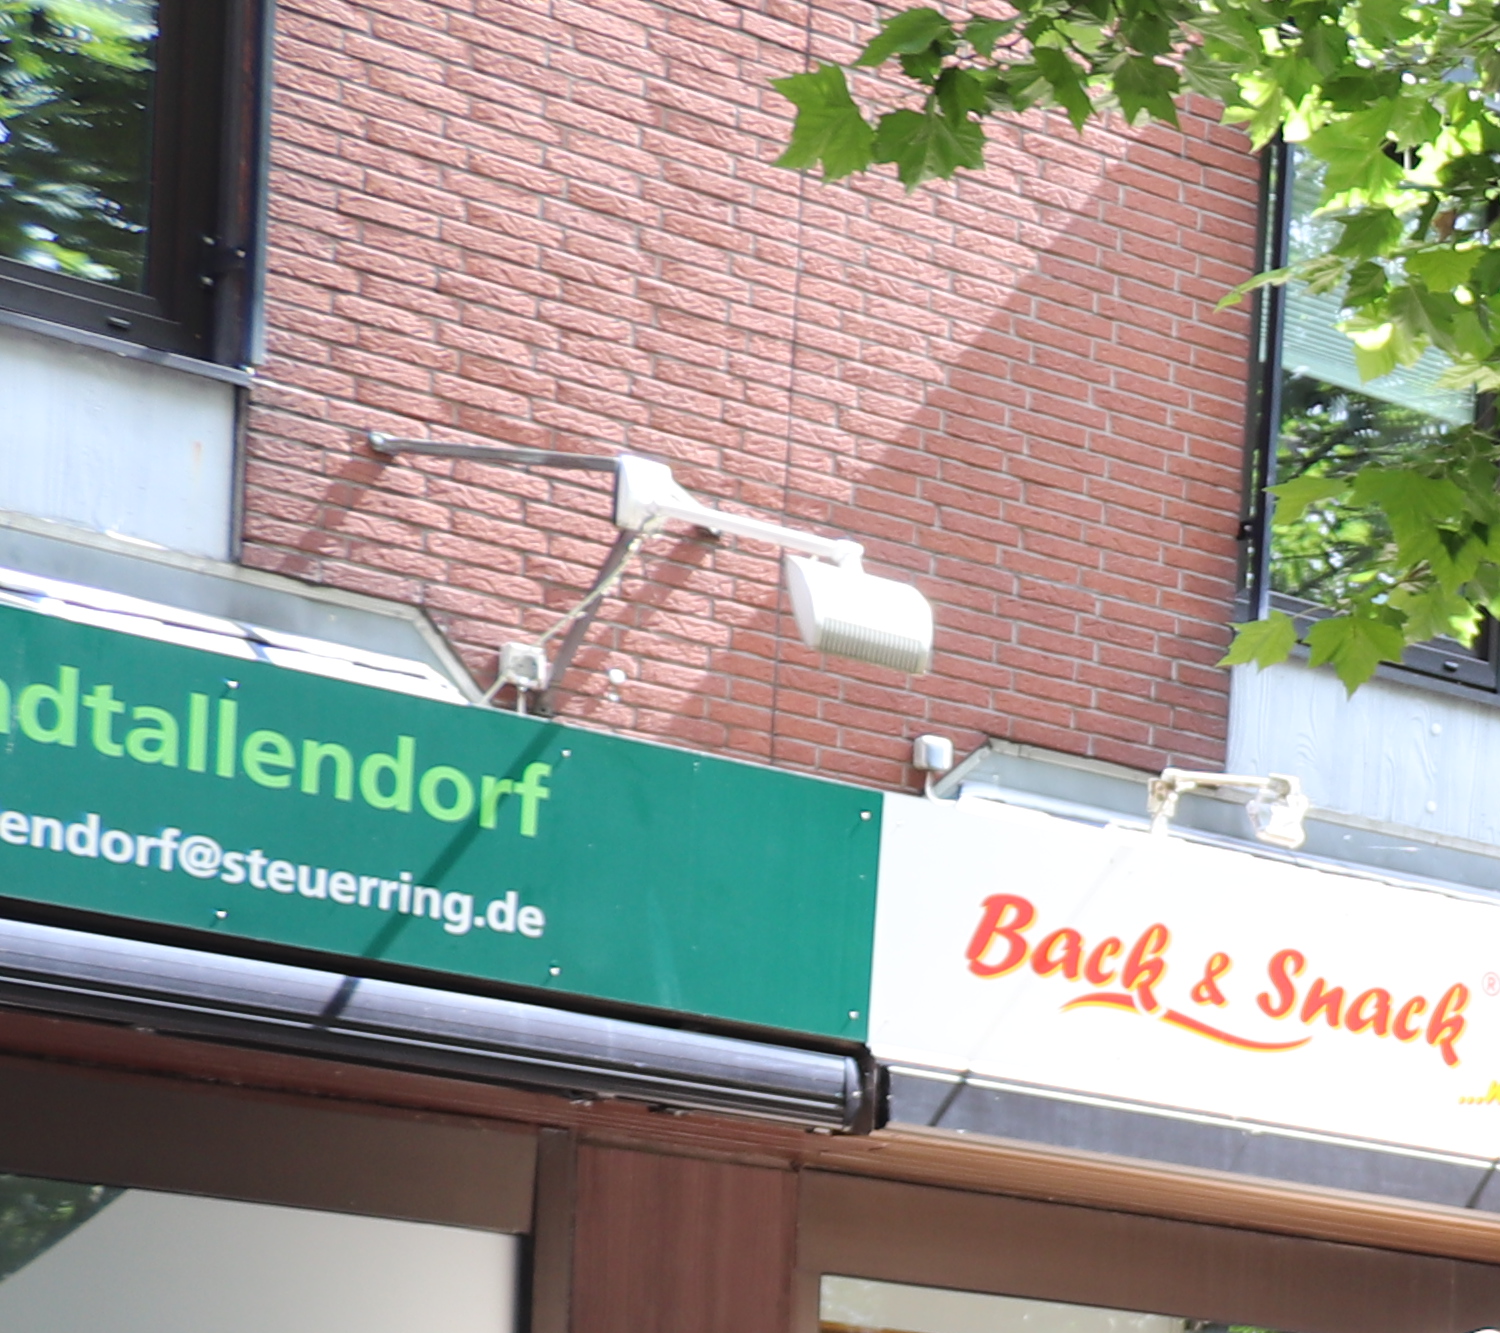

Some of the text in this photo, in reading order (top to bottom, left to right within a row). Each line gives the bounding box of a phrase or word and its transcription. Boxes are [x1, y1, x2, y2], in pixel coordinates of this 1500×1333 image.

[965, 893, 1172, 1015] Back
[1190, 951, 1233, 1009] &
[1256, 948, 1470, 1068] Snack
